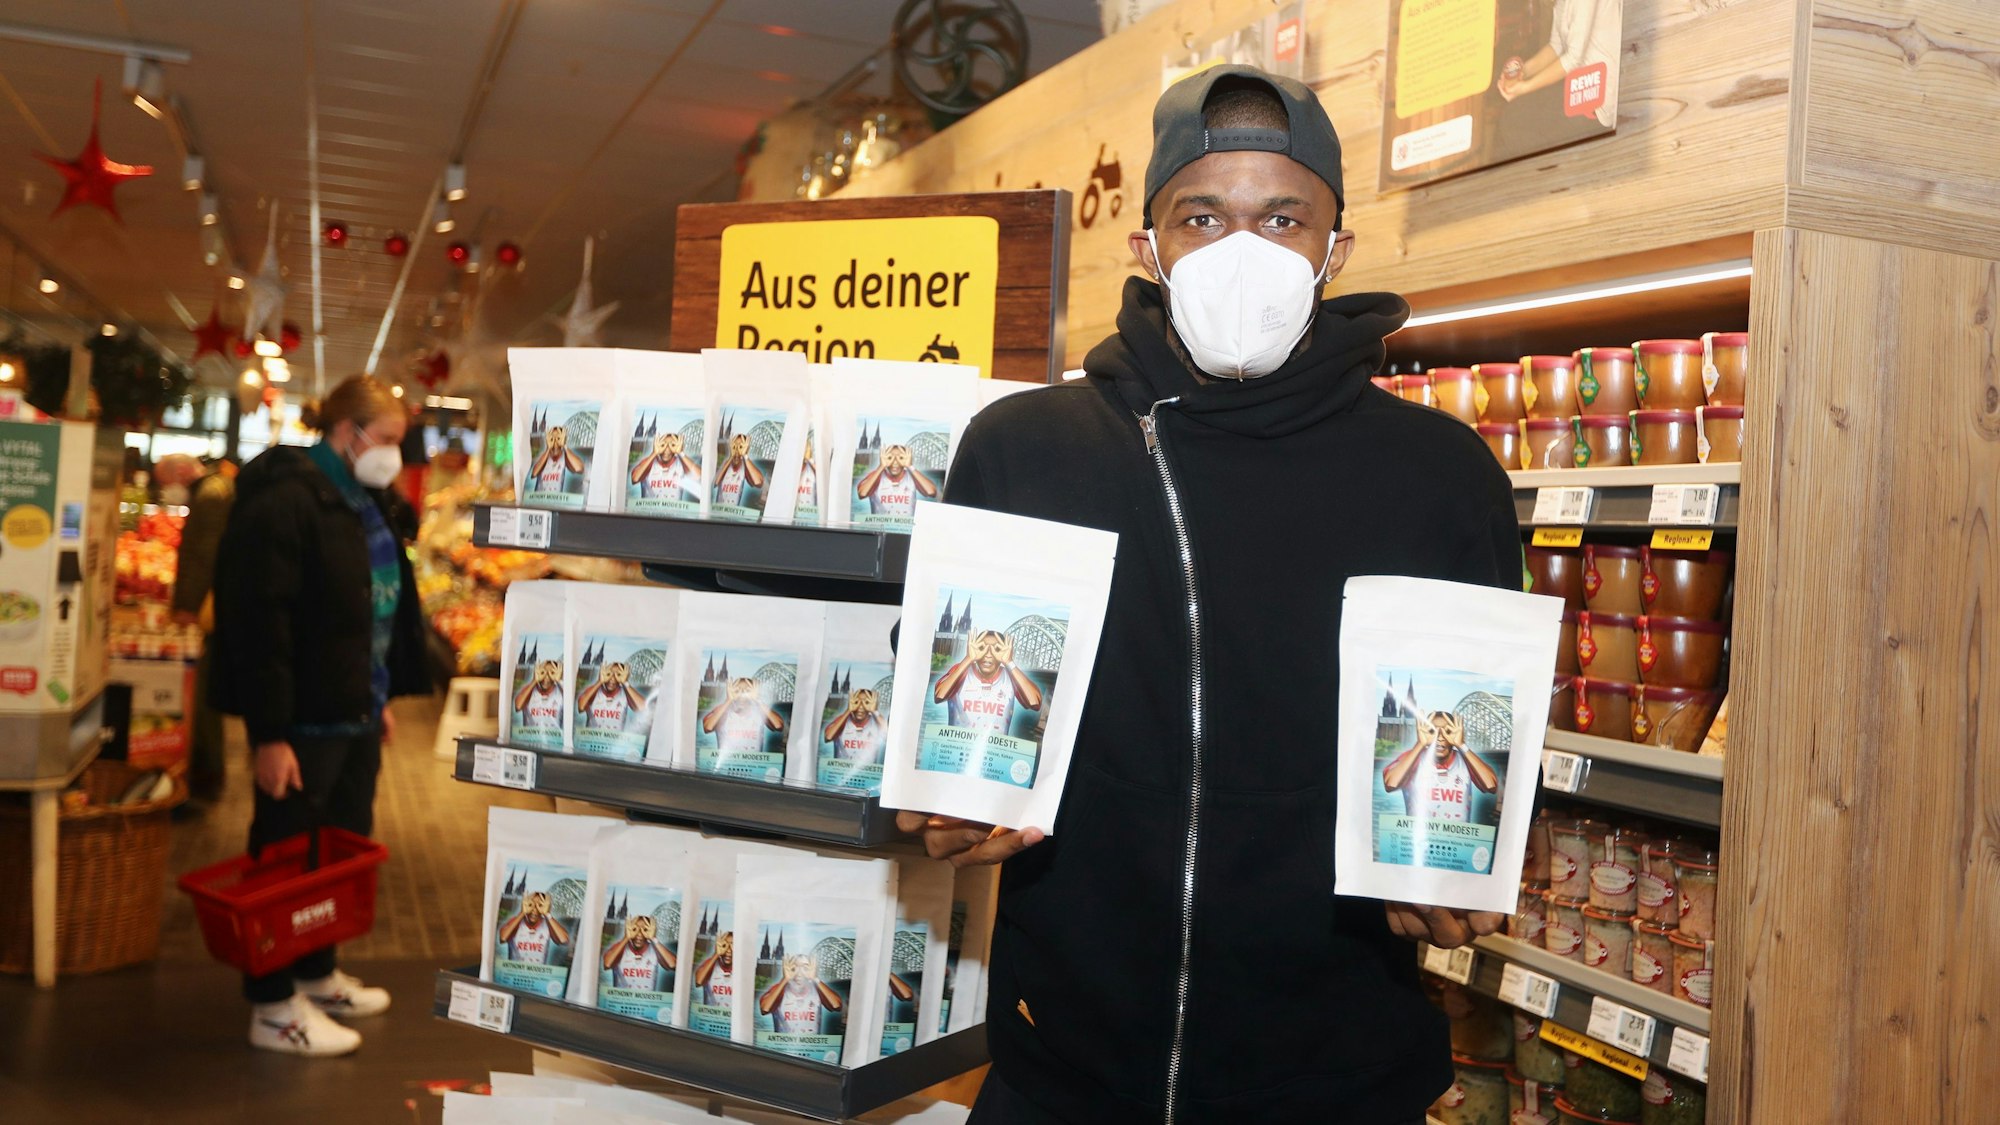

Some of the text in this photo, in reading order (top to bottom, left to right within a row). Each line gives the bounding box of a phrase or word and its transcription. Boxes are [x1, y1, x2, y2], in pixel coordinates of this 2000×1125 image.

[1570, 71, 1600, 92] REWE
[1569, 85, 1600, 107] DEIN MARKT
[740, 258, 970, 309] Aus deiner
[738, 324, 875, 364] Rion
[542, 472, 560, 482] REWE
[722, 484, 738, 493] REWE
[881, 495, 910, 504] REWE
[662, 501, 690, 510] MODESTE
[1664, 535, 1693, 546] Regional
[530, 708, 557, 718] REWE
[963, 699, 1006, 717] REWE
[593, 709, 621, 719] REWE
[938, 728, 1018, 749] ANTHONY ODESTE
[741, 753, 770, 761] MODESTE
[827, 760, 854, 768] ANTHONY
[1428, 787, 1463, 804] EWE
[1396, 819, 1480, 837] ANTNY MODESTE
[291, 898, 336, 926] REWE
[517, 941, 543, 952] REWE
[623, 968, 652, 979] REWE
[607, 989, 663, 1001] ANTHONY MODESTE
[784, 1011, 815, 1021] REWE
[767, 1035, 829, 1045] ANTHONY MODESTE
[1601, 1049, 1630, 1067] Regional
